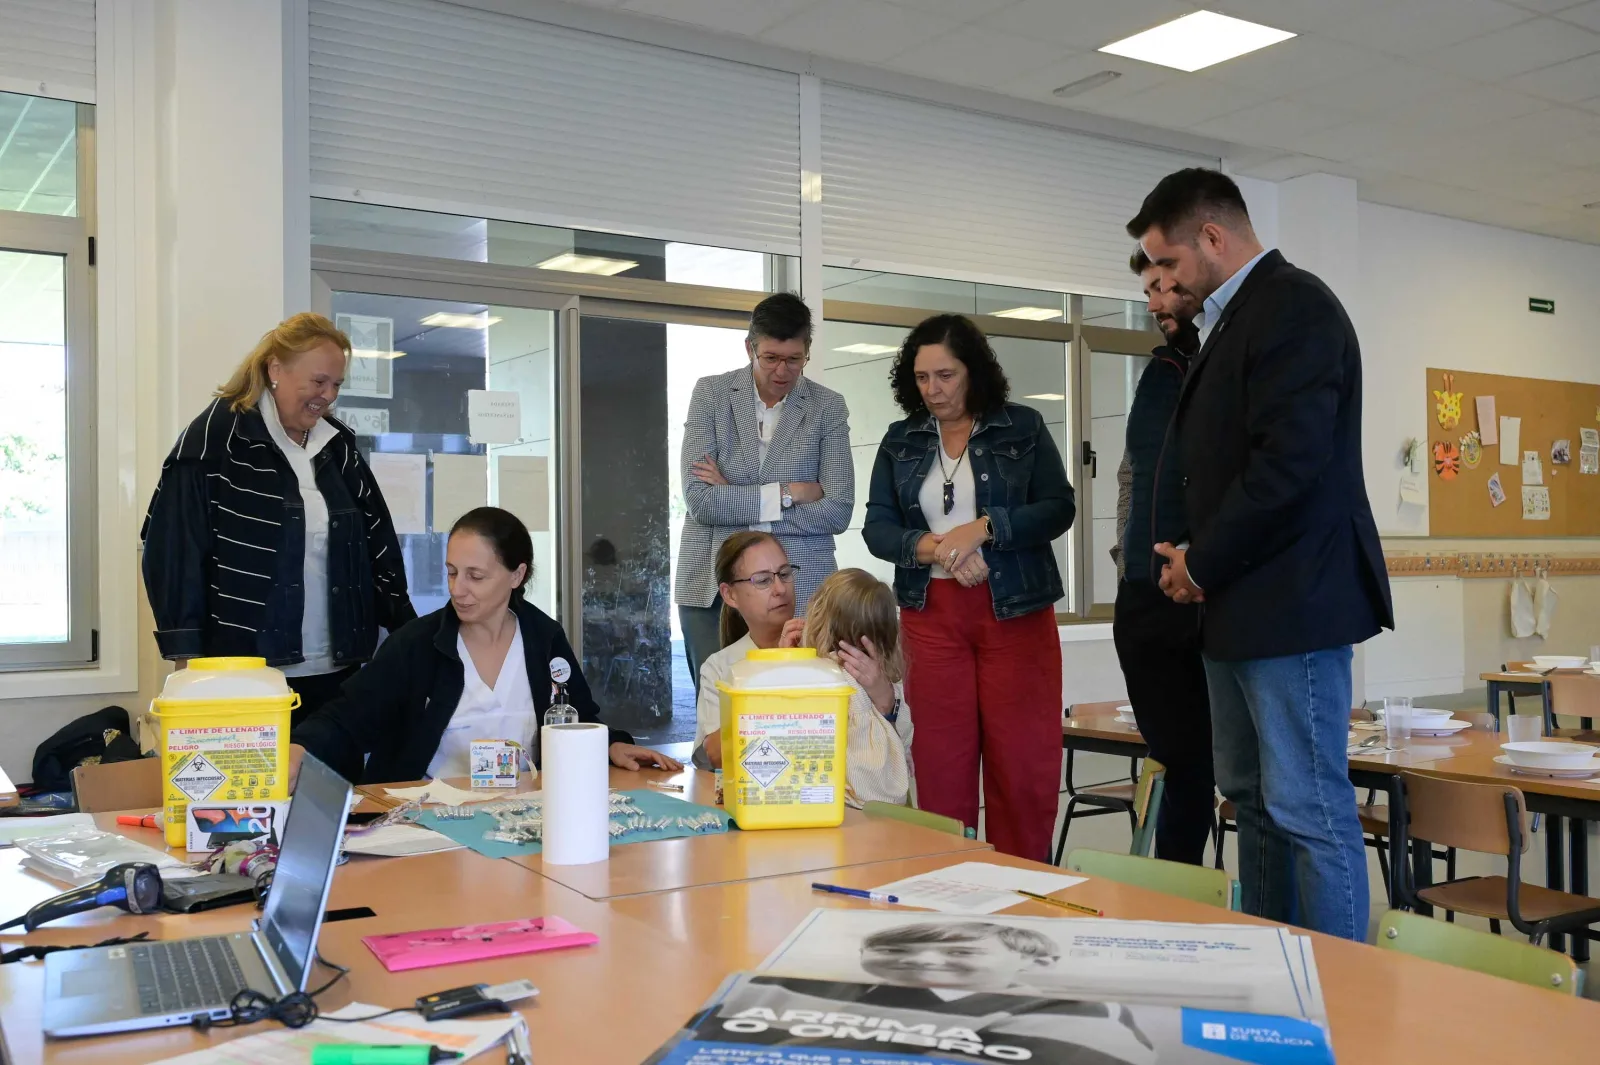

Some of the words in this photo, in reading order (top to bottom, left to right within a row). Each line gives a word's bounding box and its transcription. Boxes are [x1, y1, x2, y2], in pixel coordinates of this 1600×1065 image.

[731, 1006, 984, 1044] ARRIMA
[1230, 1026, 1281, 1038] XUNTA
[722, 1017, 769, 1034] O
[788, 1023, 1033, 1061] OMBRO
[1229, 1034, 1249, 1042] DE
[1254, 1036, 1315, 1047] GALICIA
